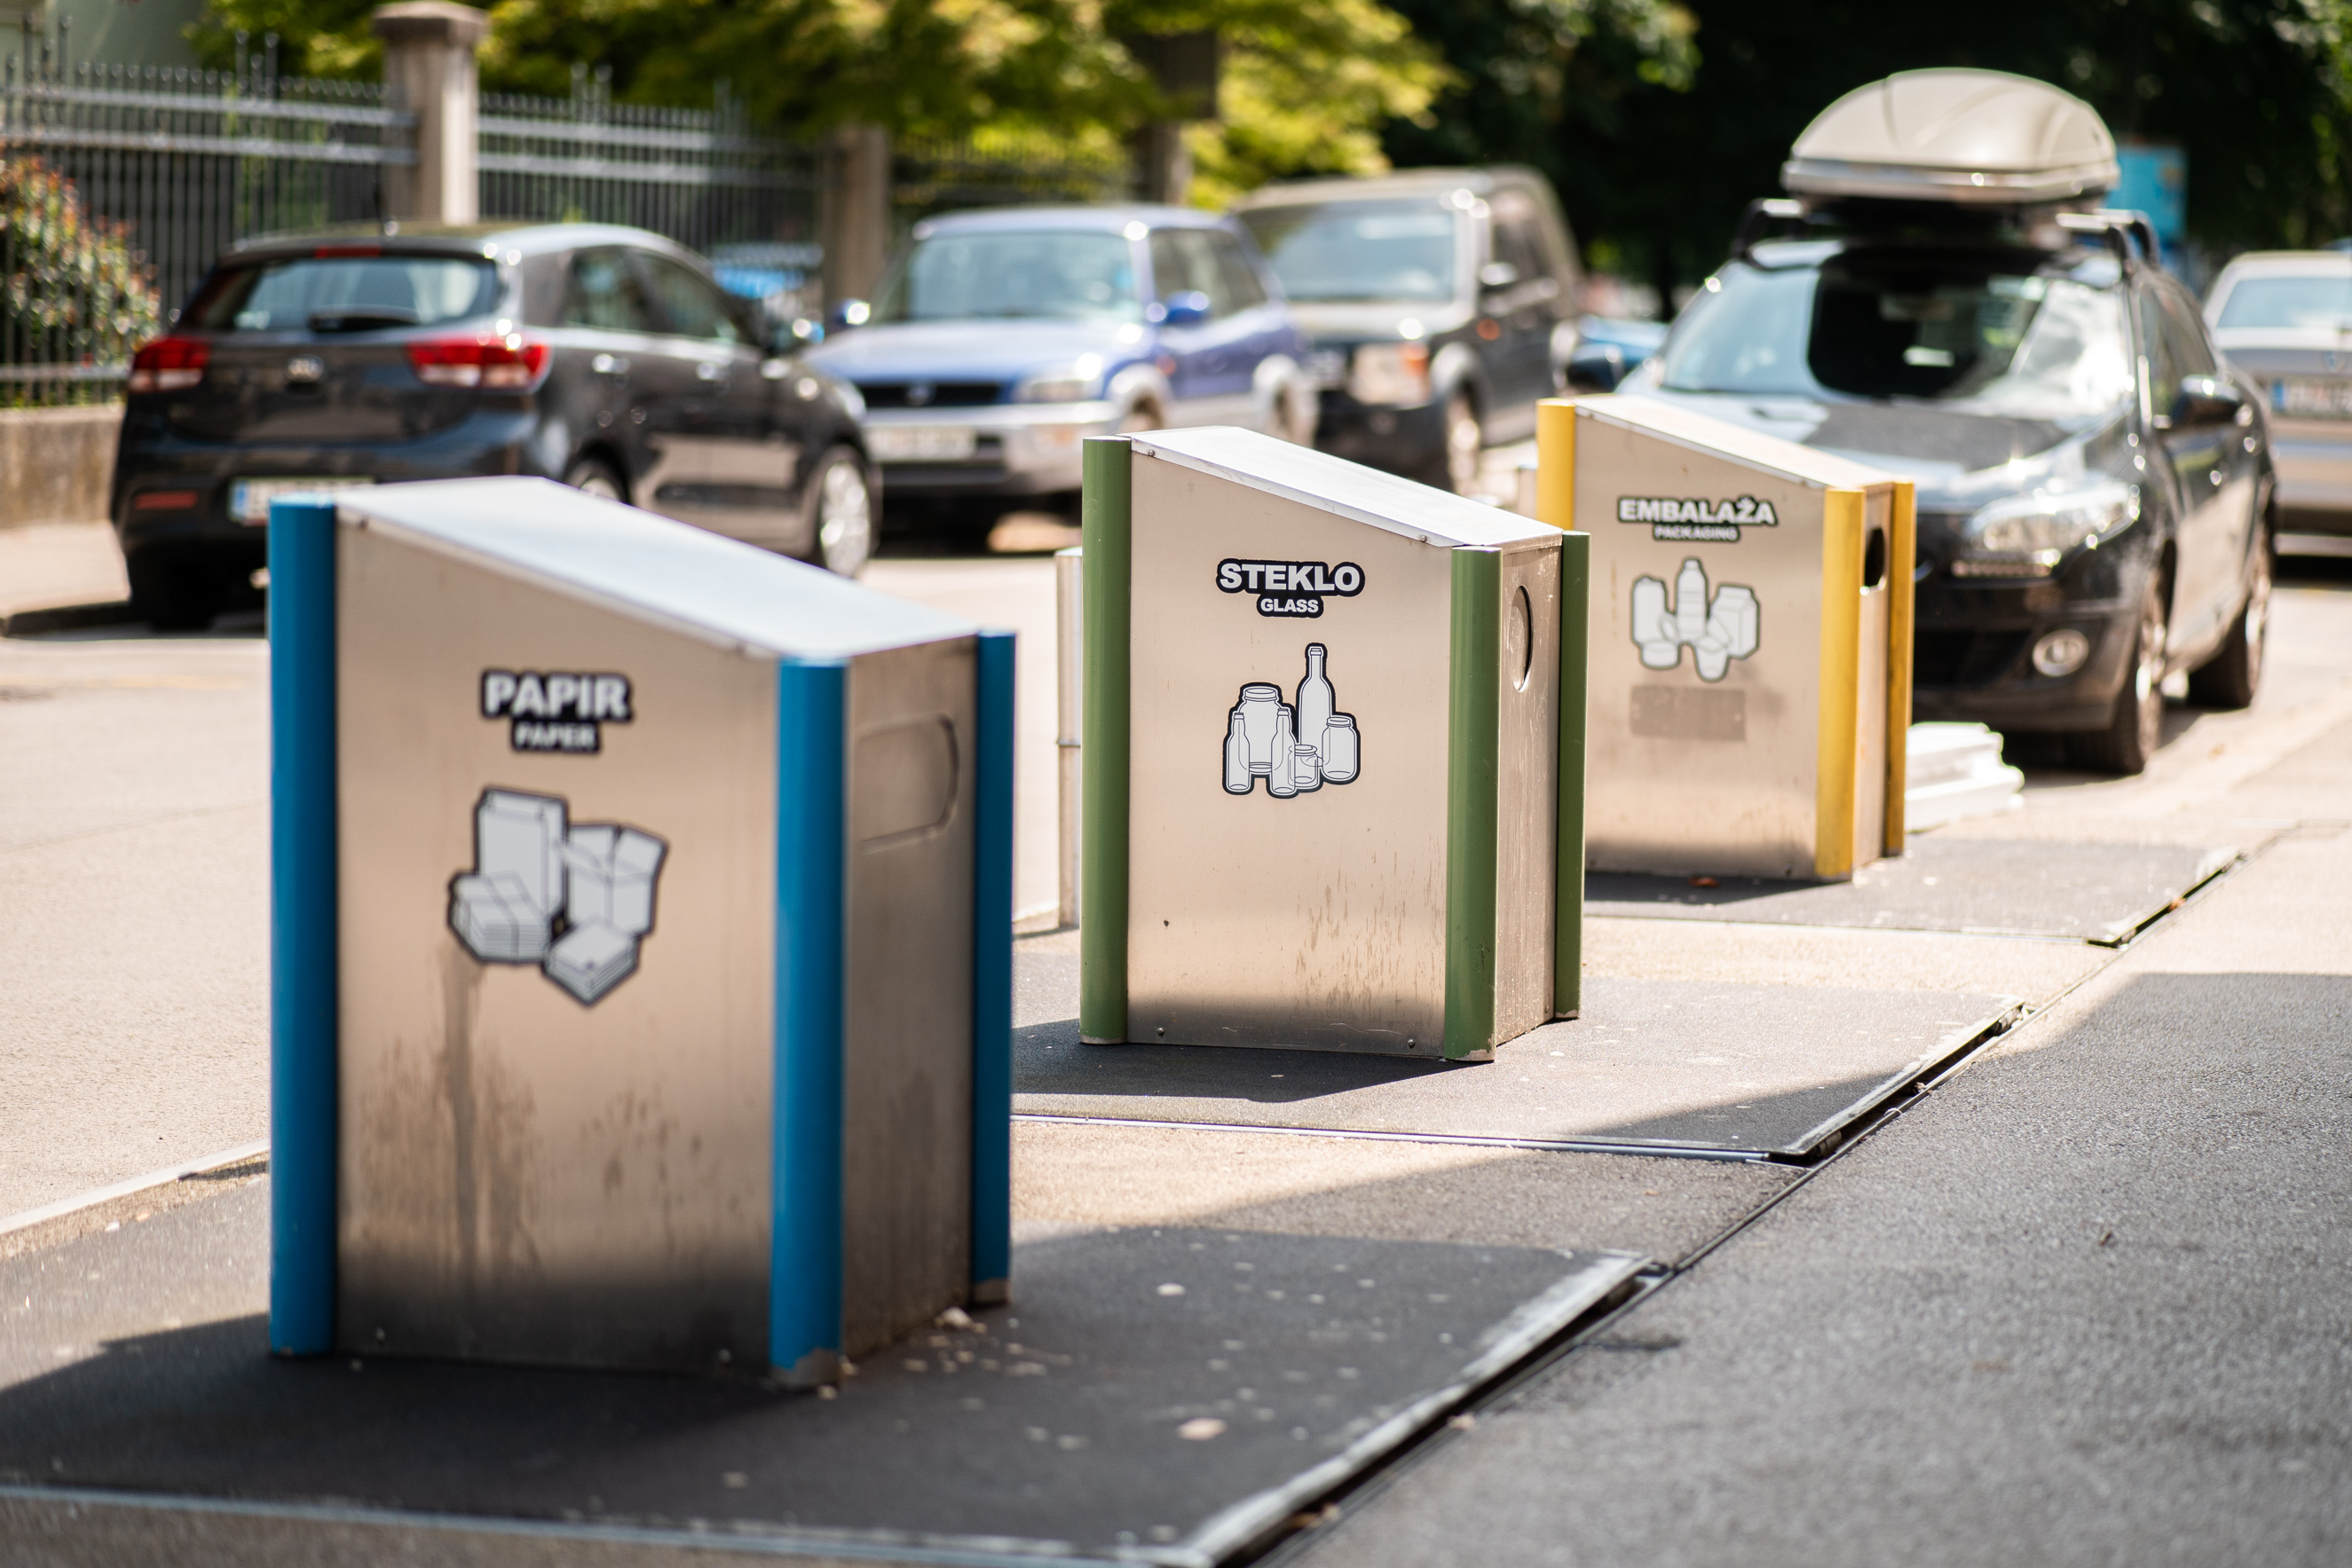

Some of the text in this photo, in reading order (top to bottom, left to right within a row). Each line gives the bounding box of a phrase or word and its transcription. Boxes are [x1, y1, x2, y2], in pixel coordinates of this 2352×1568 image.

[1620, 497, 1775, 524] EMBALAŽA
[1654, 525, 1737, 540] PACKAGING
[1219, 563, 1361, 592] STEKLO
[1260, 598, 1319, 613] GLASS
[485, 673, 628, 719] PAPIR
[515, 721, 596, 749] PAPER
